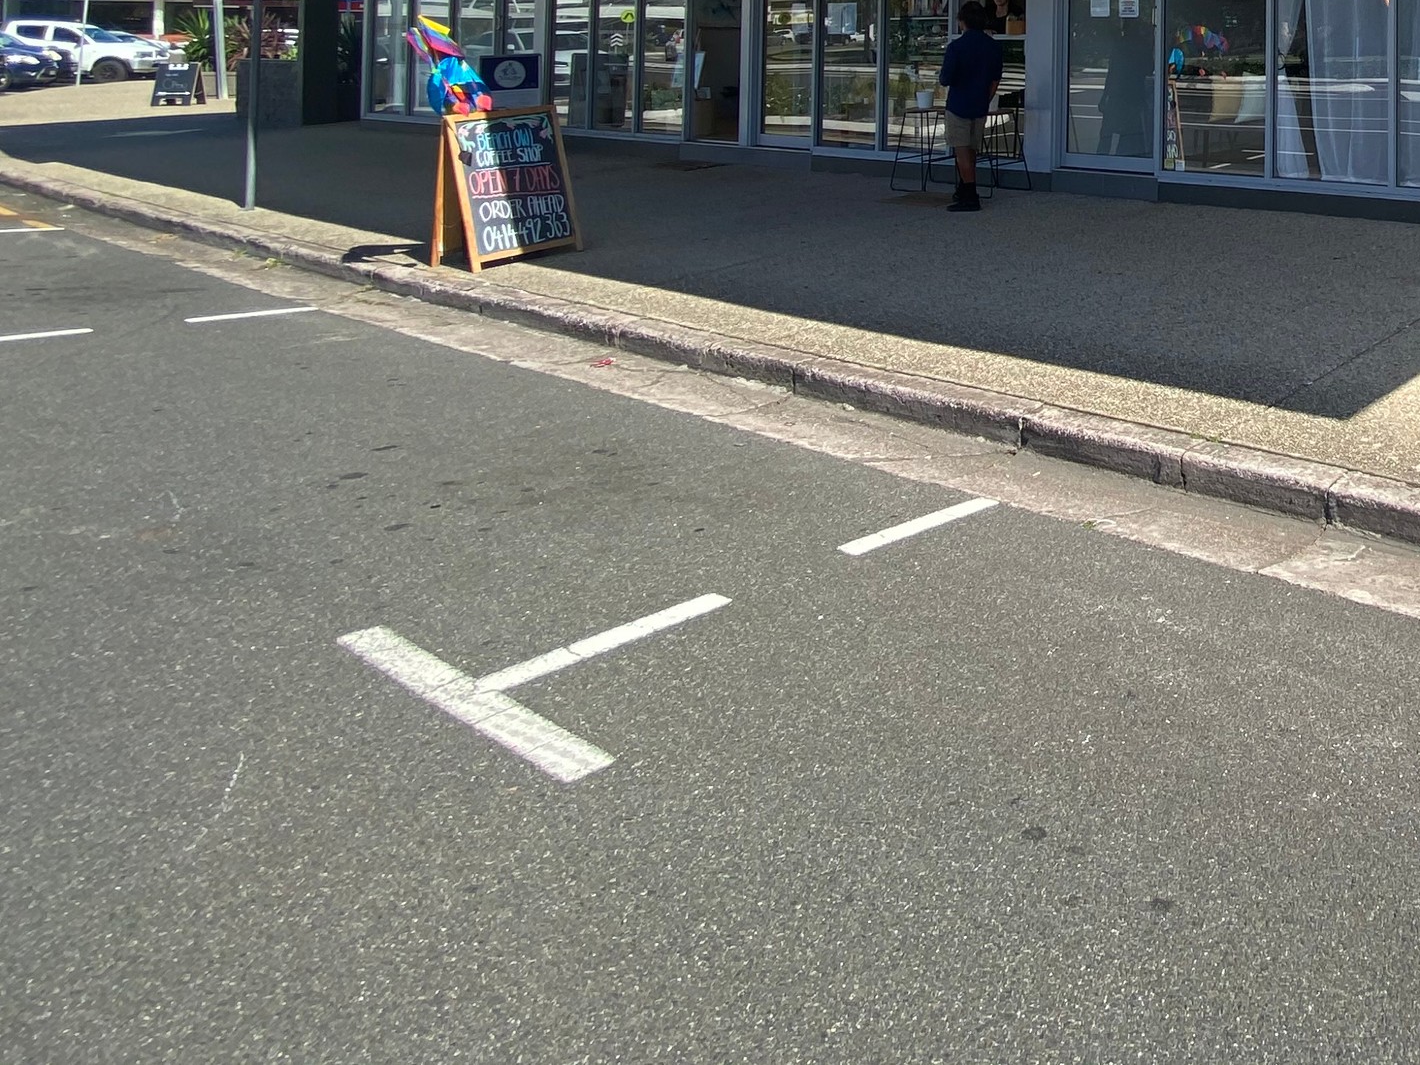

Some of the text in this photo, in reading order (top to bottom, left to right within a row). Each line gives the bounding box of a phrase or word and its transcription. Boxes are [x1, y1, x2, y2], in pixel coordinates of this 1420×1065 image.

[476, 129, 534, 151] BEACH OWL
[475, 144, 544, 167] COFFEE SHOP
[469, 164, 560, 195] OPEN 7 DAYS
[479, 194, 565, 223] ORDER AHEAD
[483, 211, 571, 252] 0414 492 363
